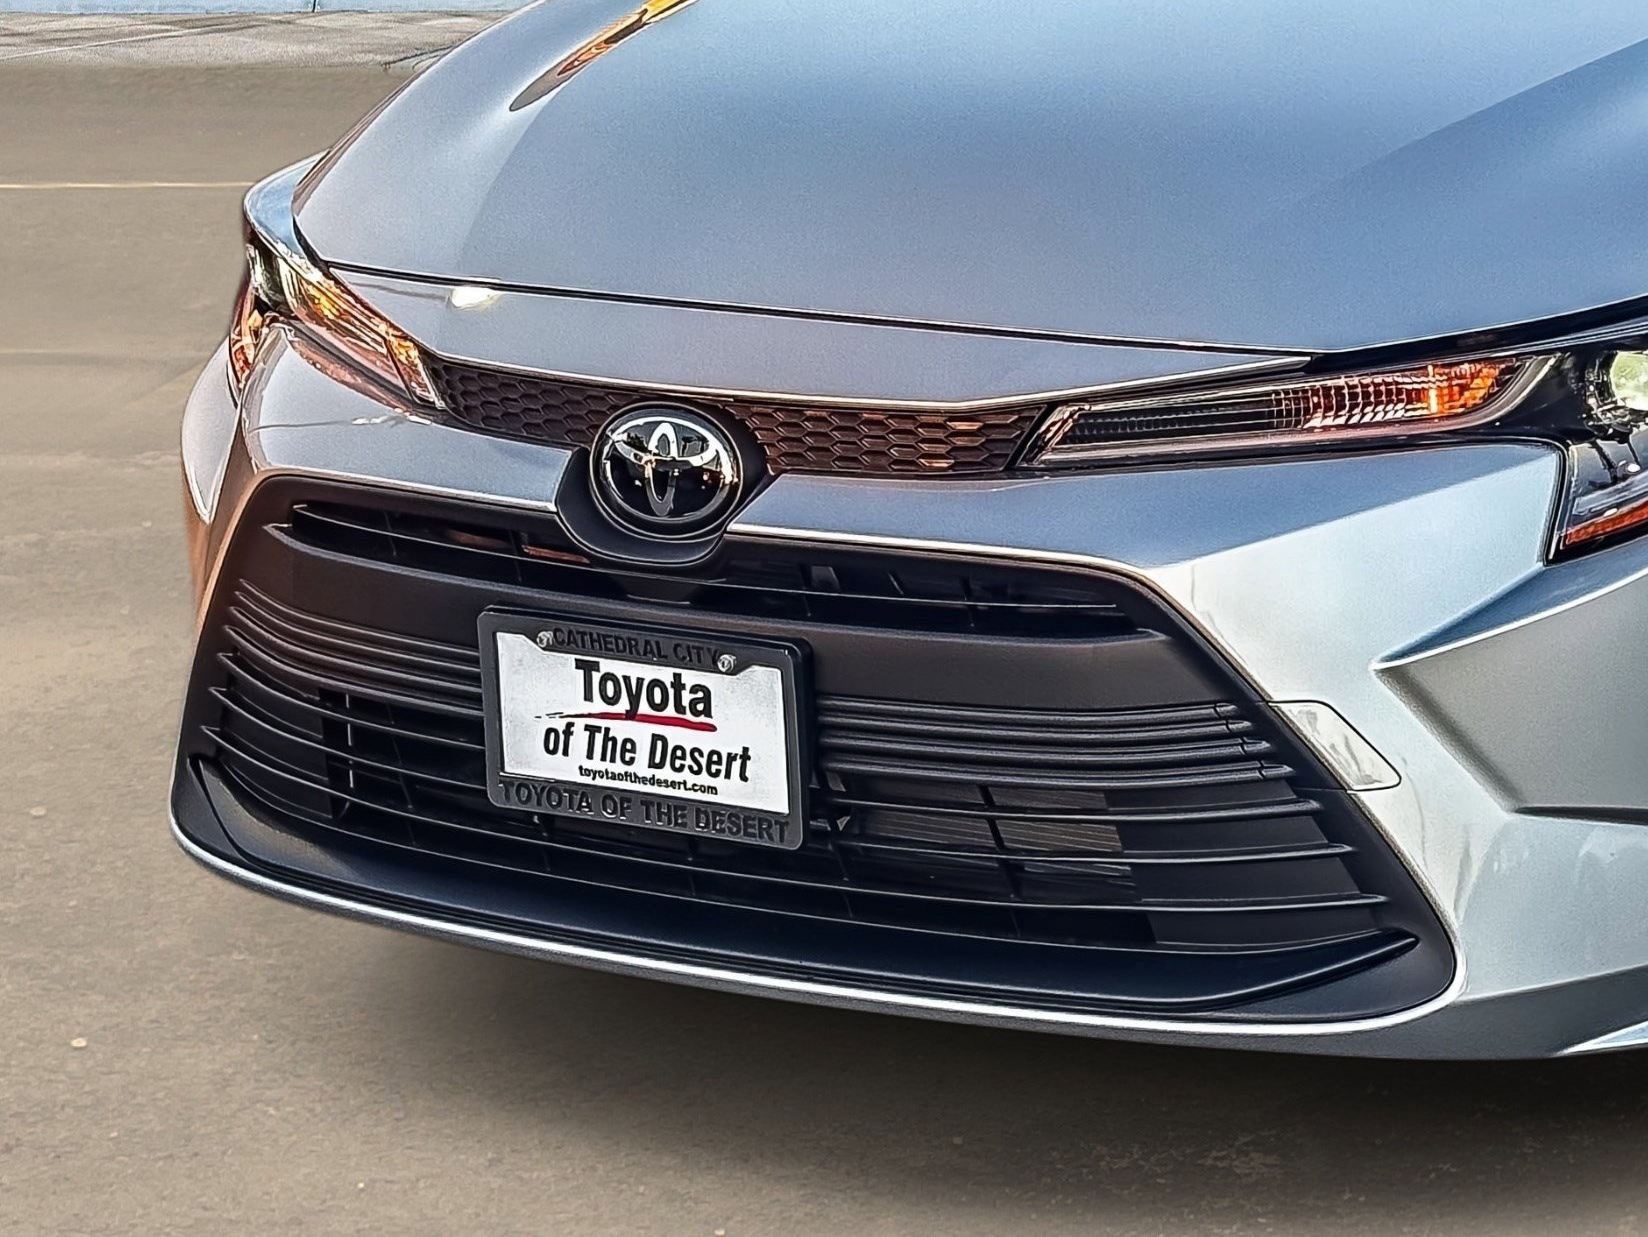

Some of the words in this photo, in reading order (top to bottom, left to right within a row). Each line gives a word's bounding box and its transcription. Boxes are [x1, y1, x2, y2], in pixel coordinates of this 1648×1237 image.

[552, 627, 668, 660] CATHEDRAL
[674, 644, 720, 665] CITY
[575, 658, 713, 719] Toyota
[543, 722, 575, 757] of
[584, 724, 636, 766] The
[648, 733, 751, 783] Desert
[578, 765, 718, 796] toyotaofthedesert.com
[499, 780, 593, 815] TOYOTA
[600, 794, 632, 820] OF
[640, 798, 688, 830] THE
[695, 806, 790, 845] DESERT
